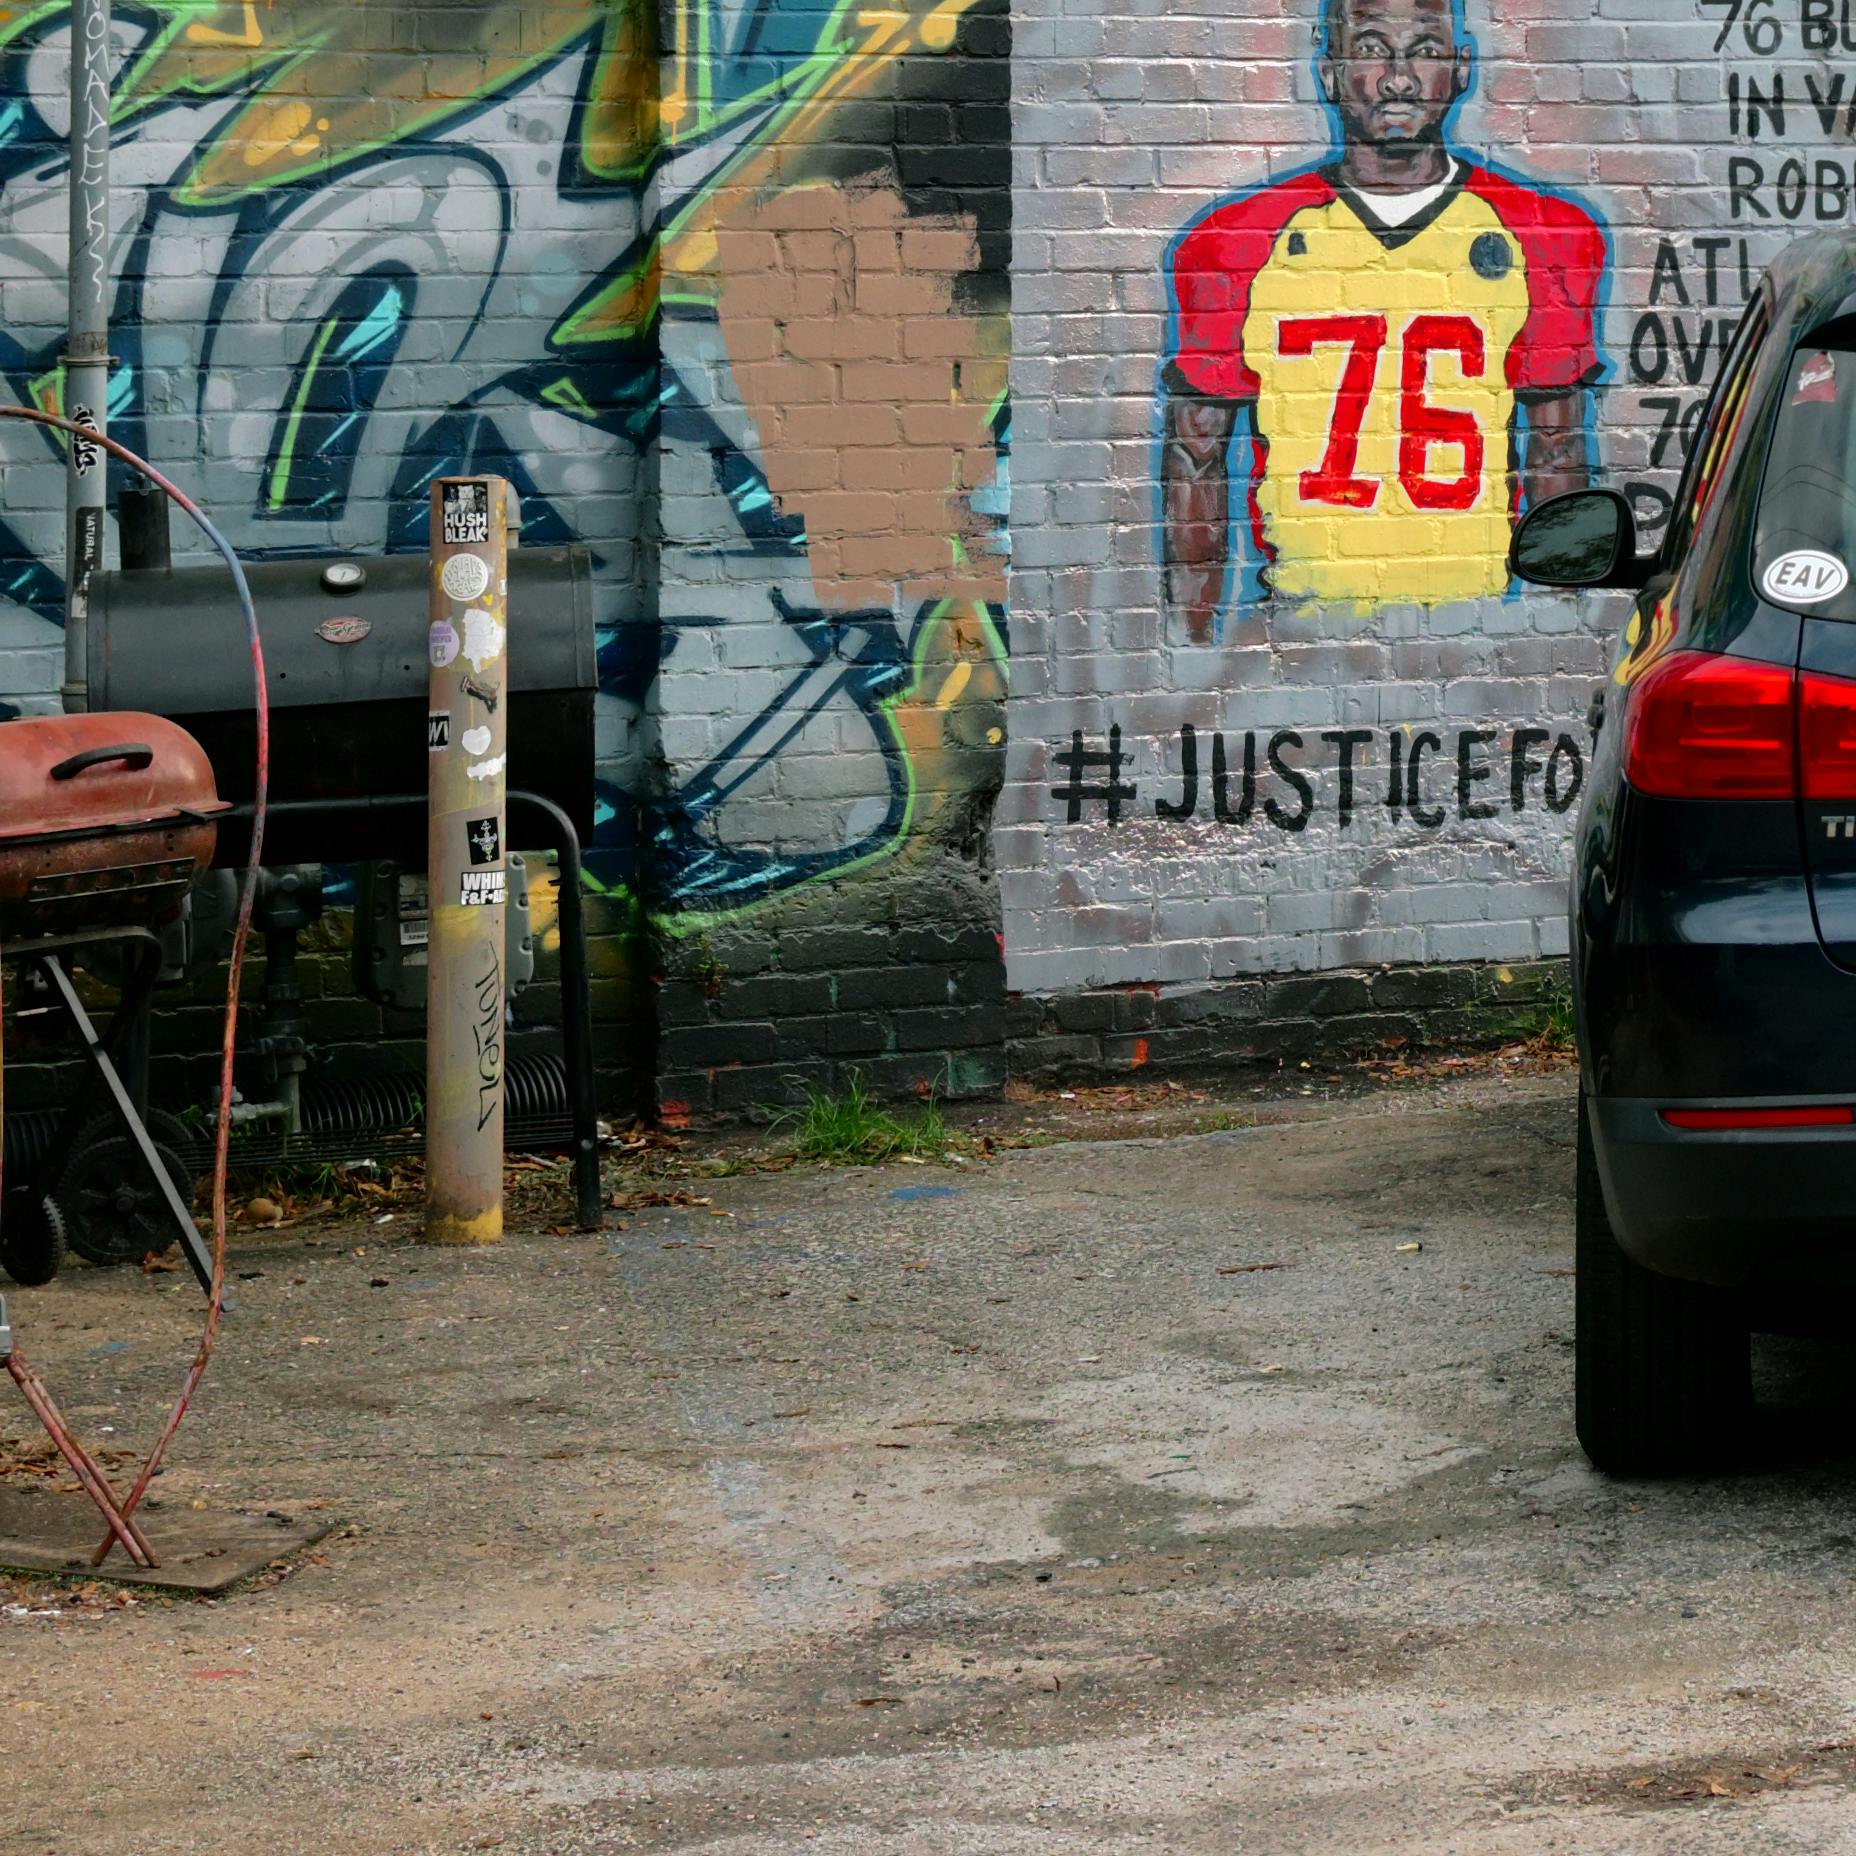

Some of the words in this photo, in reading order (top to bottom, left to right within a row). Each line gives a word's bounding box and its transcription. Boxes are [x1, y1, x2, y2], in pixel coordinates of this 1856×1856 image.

[1728, 72, 1786, 137] IN
[1276, 313, 1486, 513] 76
[444, 513, 487, 527] HUSH
[1775, 561, 1837, 591] EAV
[1051, 723, 1593, 831] #JUSTICEFO
